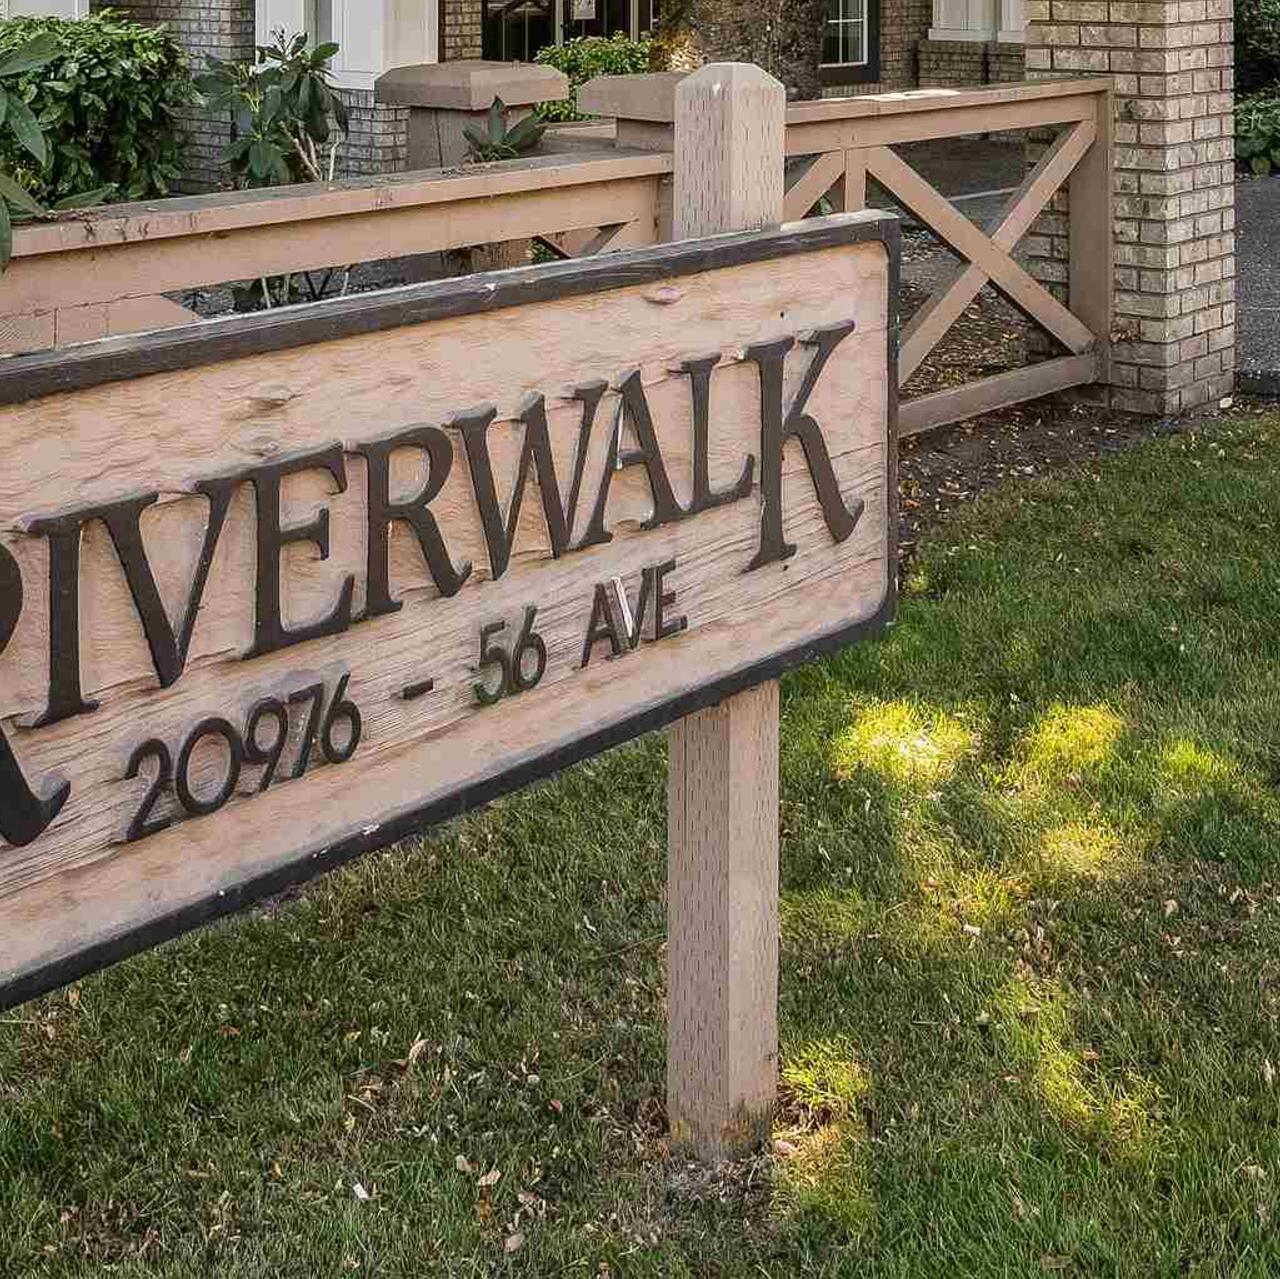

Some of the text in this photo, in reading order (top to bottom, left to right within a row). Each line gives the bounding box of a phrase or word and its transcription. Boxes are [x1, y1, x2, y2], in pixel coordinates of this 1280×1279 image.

[124, 674, 363, 841] 20976
[473, 606, 545, 706] 56
[582, 558, 688, 668] AVE
